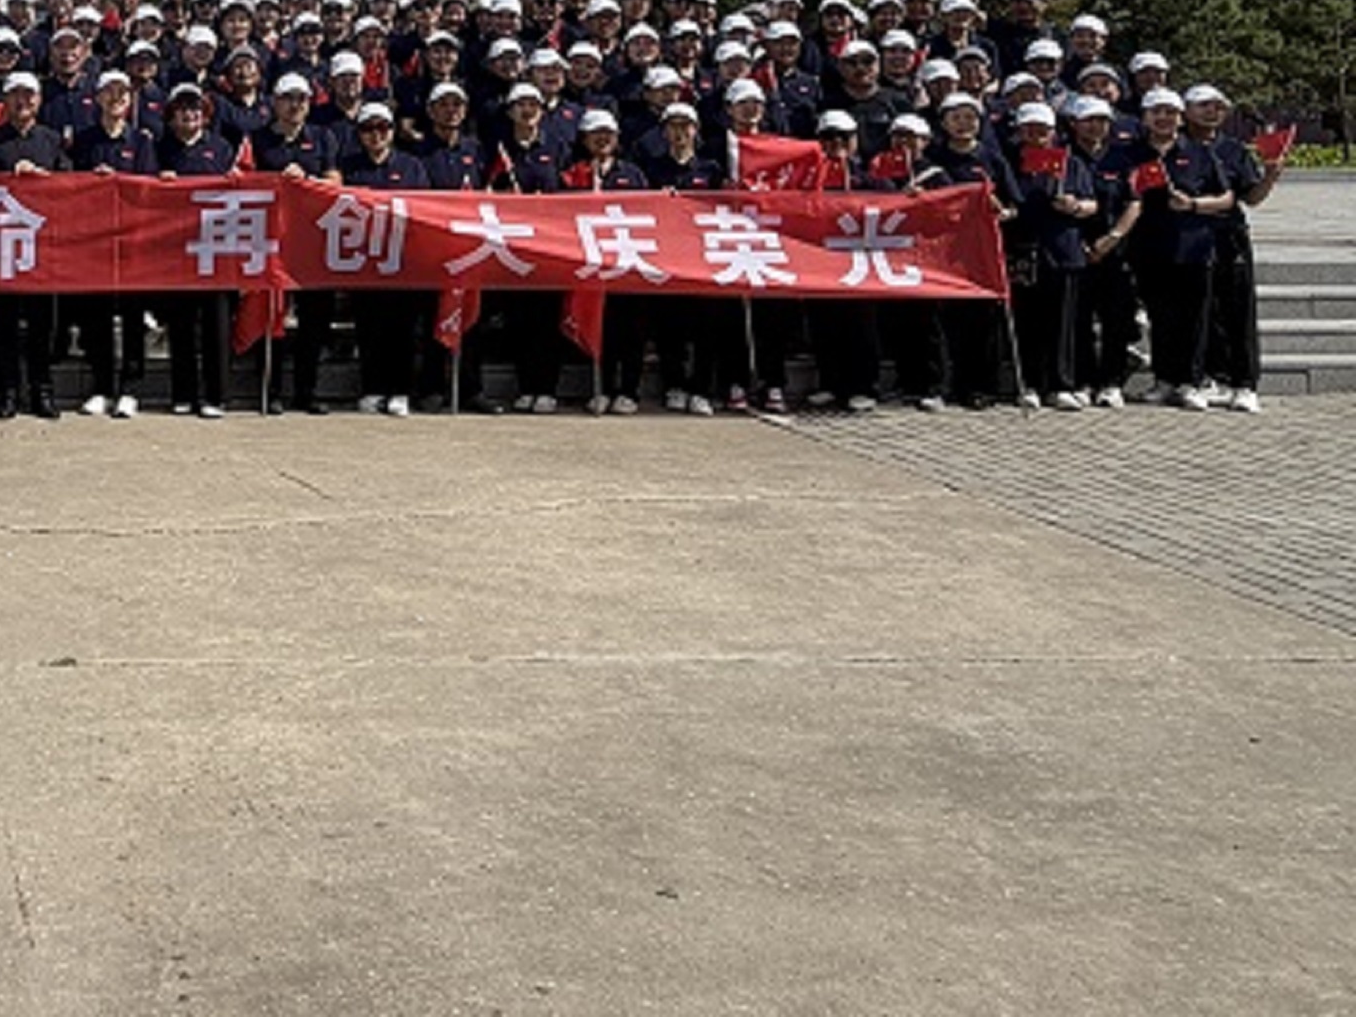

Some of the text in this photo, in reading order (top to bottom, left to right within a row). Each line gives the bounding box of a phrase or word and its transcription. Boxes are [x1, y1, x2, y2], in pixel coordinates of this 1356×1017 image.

[185, 190, 923, 287] 再创大庆荣光
